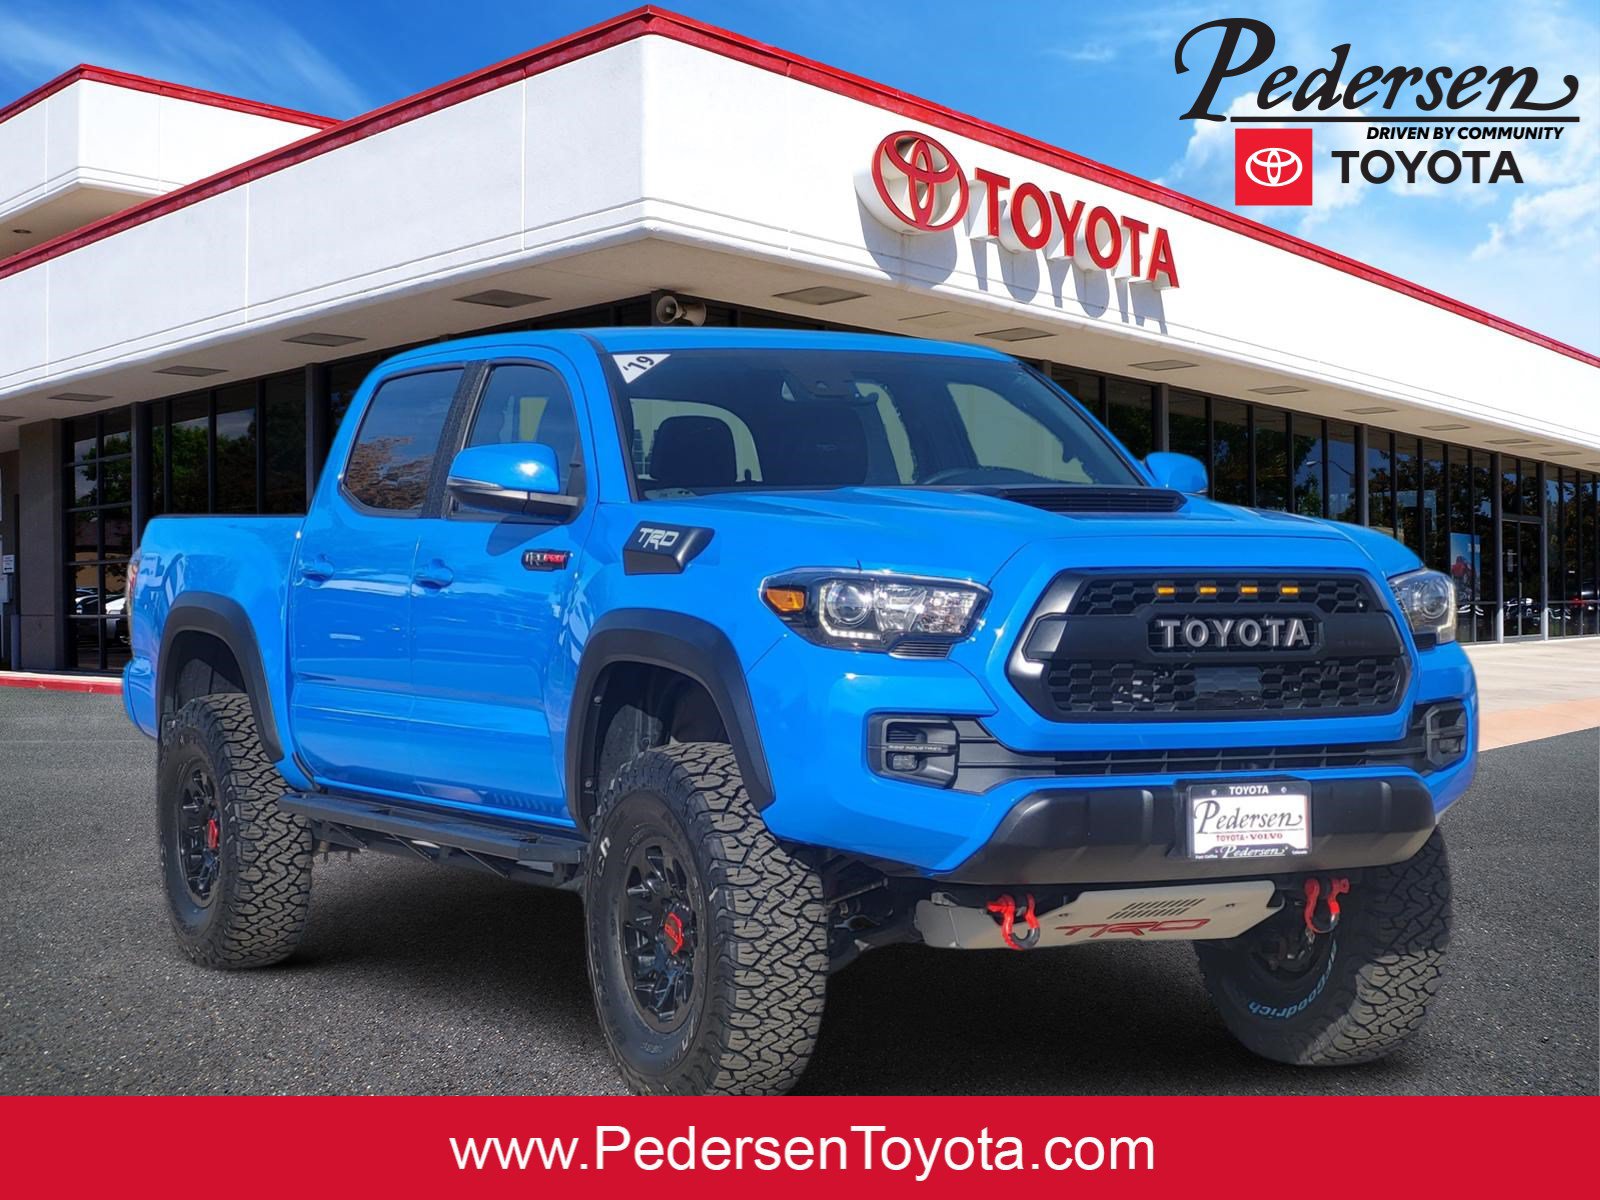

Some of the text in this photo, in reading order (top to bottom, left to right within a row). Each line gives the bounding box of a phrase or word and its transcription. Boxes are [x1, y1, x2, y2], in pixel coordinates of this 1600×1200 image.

[975, 167, 1180, 289] TOYOTA
[637, 527, 680, 550] TRD
[1158, 618, 1310, 648] TOYOTA
[1228, 785, 1270, 796] TOYOTA
[1193, 799, 1304, 835] Pedersen
[1219, 845, 1286, 859] Pedersen
[1055, 917, 1211, 938] TRD
